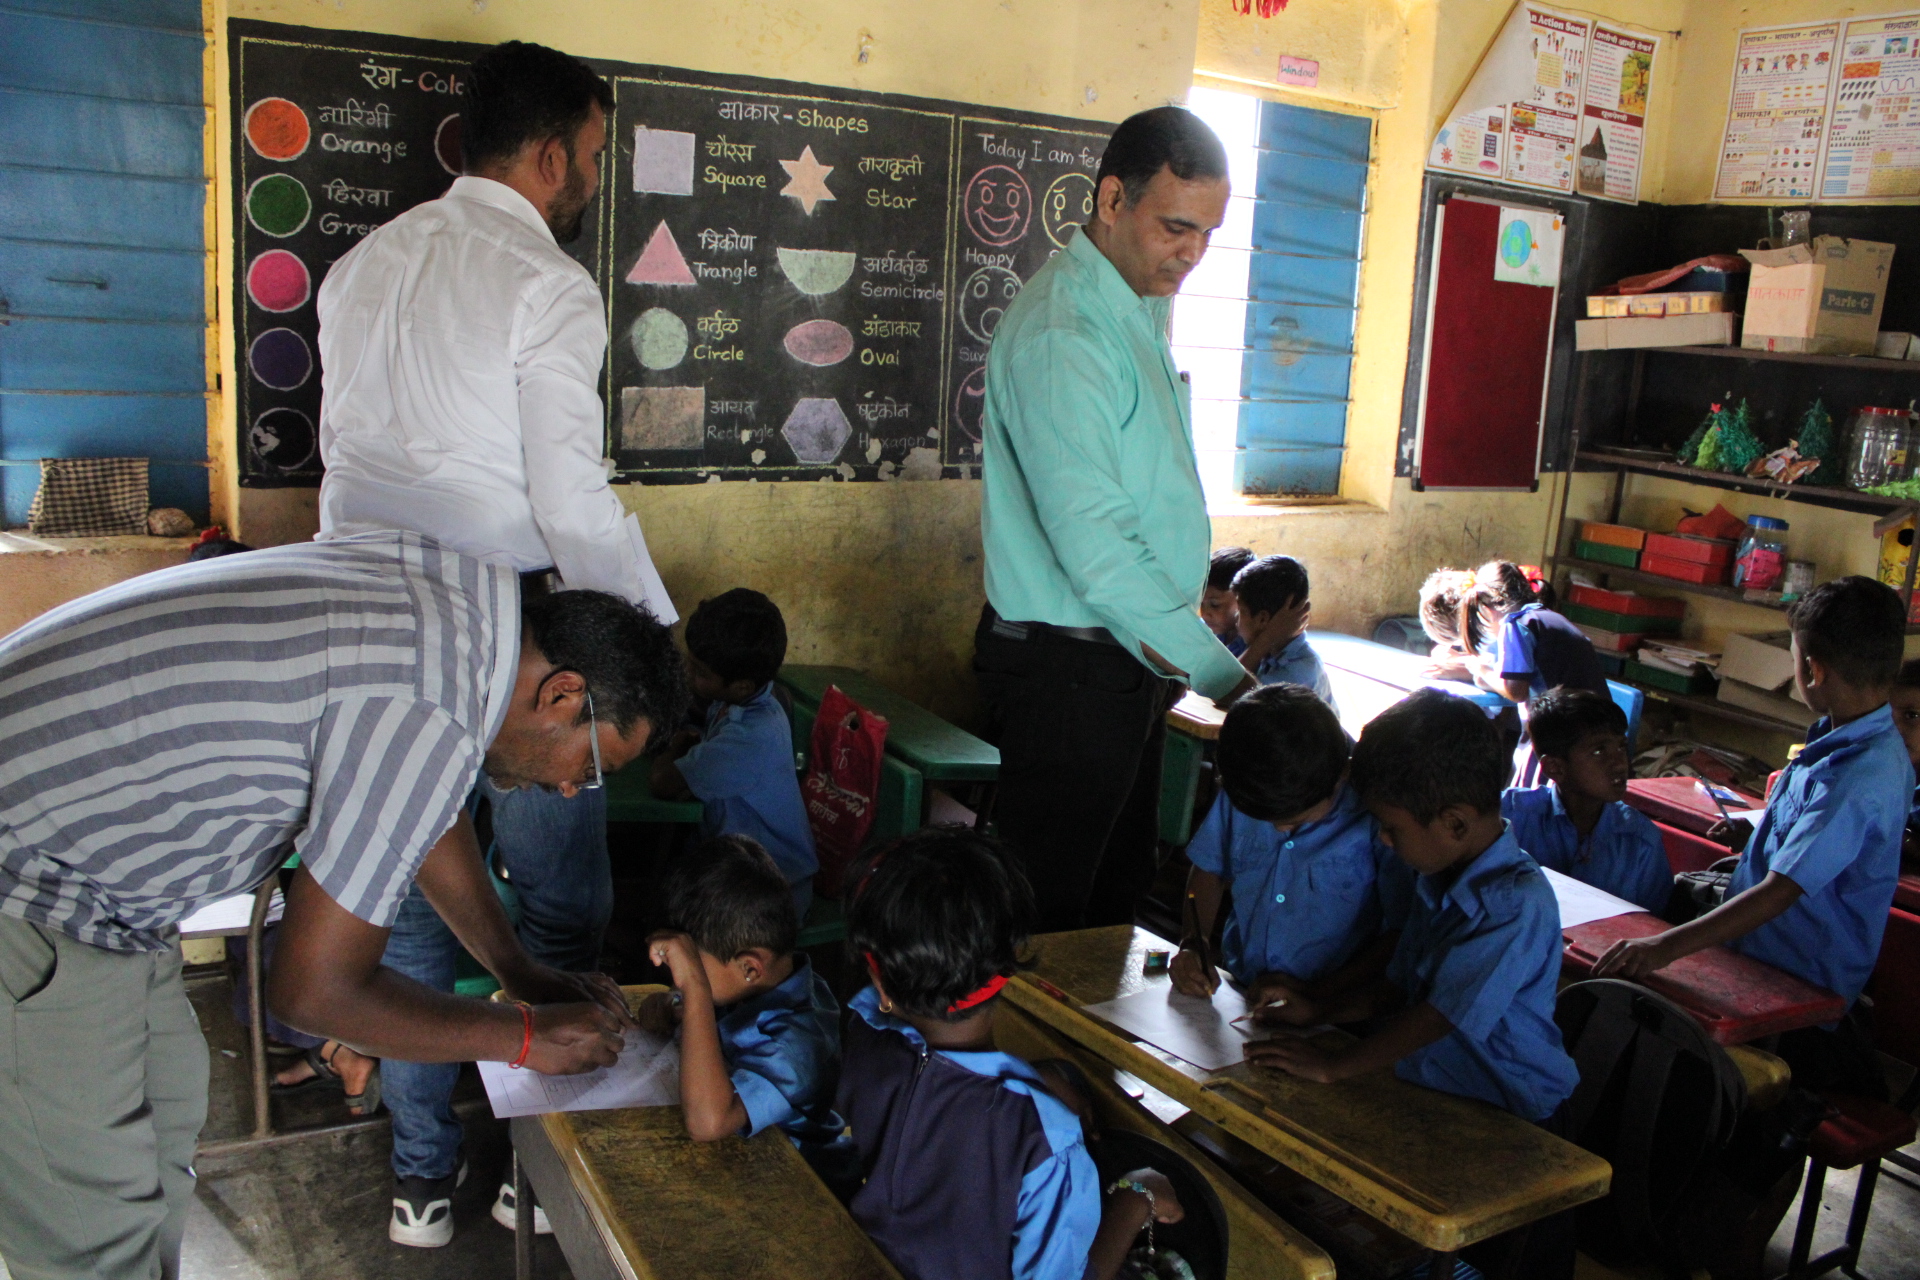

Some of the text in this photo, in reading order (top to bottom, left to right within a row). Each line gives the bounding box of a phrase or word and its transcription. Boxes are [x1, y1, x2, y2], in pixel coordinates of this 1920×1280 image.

[1538, 15, 1564, 30] Action
[1566, 22, 1586, 37] Song
[360, 58, 402, 90] रंग
[419, 71, 465, 95] Colo
[1280, 64, 1317, 78] Window
[718, 101, 782, 125] आकार
[796, 109, 869, 135] Shapes
[320, 133, 407, 164] Orange
[705, 134, 756, 163] चौरस
[977, 133, 1026, 170] Today
[1031, 140, 1042, 162] I
[1048, 149, 1075, 165] am
[703, 166, 767, 194] Square
[858, 154, 925, 181] ताराकृती
[322, 178, 394, 206] हिरवा
[866, 189, 917, 210] Star
[697, 226, 757, 253] त्रिकोण
[692, 258, 758, 285] Trangle
[862, 249, 930, 282] अर्धवर्तुळ
[965, 247, 1016, 270] Happy
[861, 280, 944, 301] Semicircle
[1826, 293, 1869, 310] Parle-G
[697, 310, 741, 340] वर्तुळ
[861, 313, 922, 339] अंडाकार
[693, 345, 744, 363] Circle
[860, 347, 899, 366] Oval
[959, 346, 986, 362] Sur
[709, 400, 757, 417] आयत
[706, 418, 774, 443] Rectngle
[859, 432, 926, 448] Hxagon
